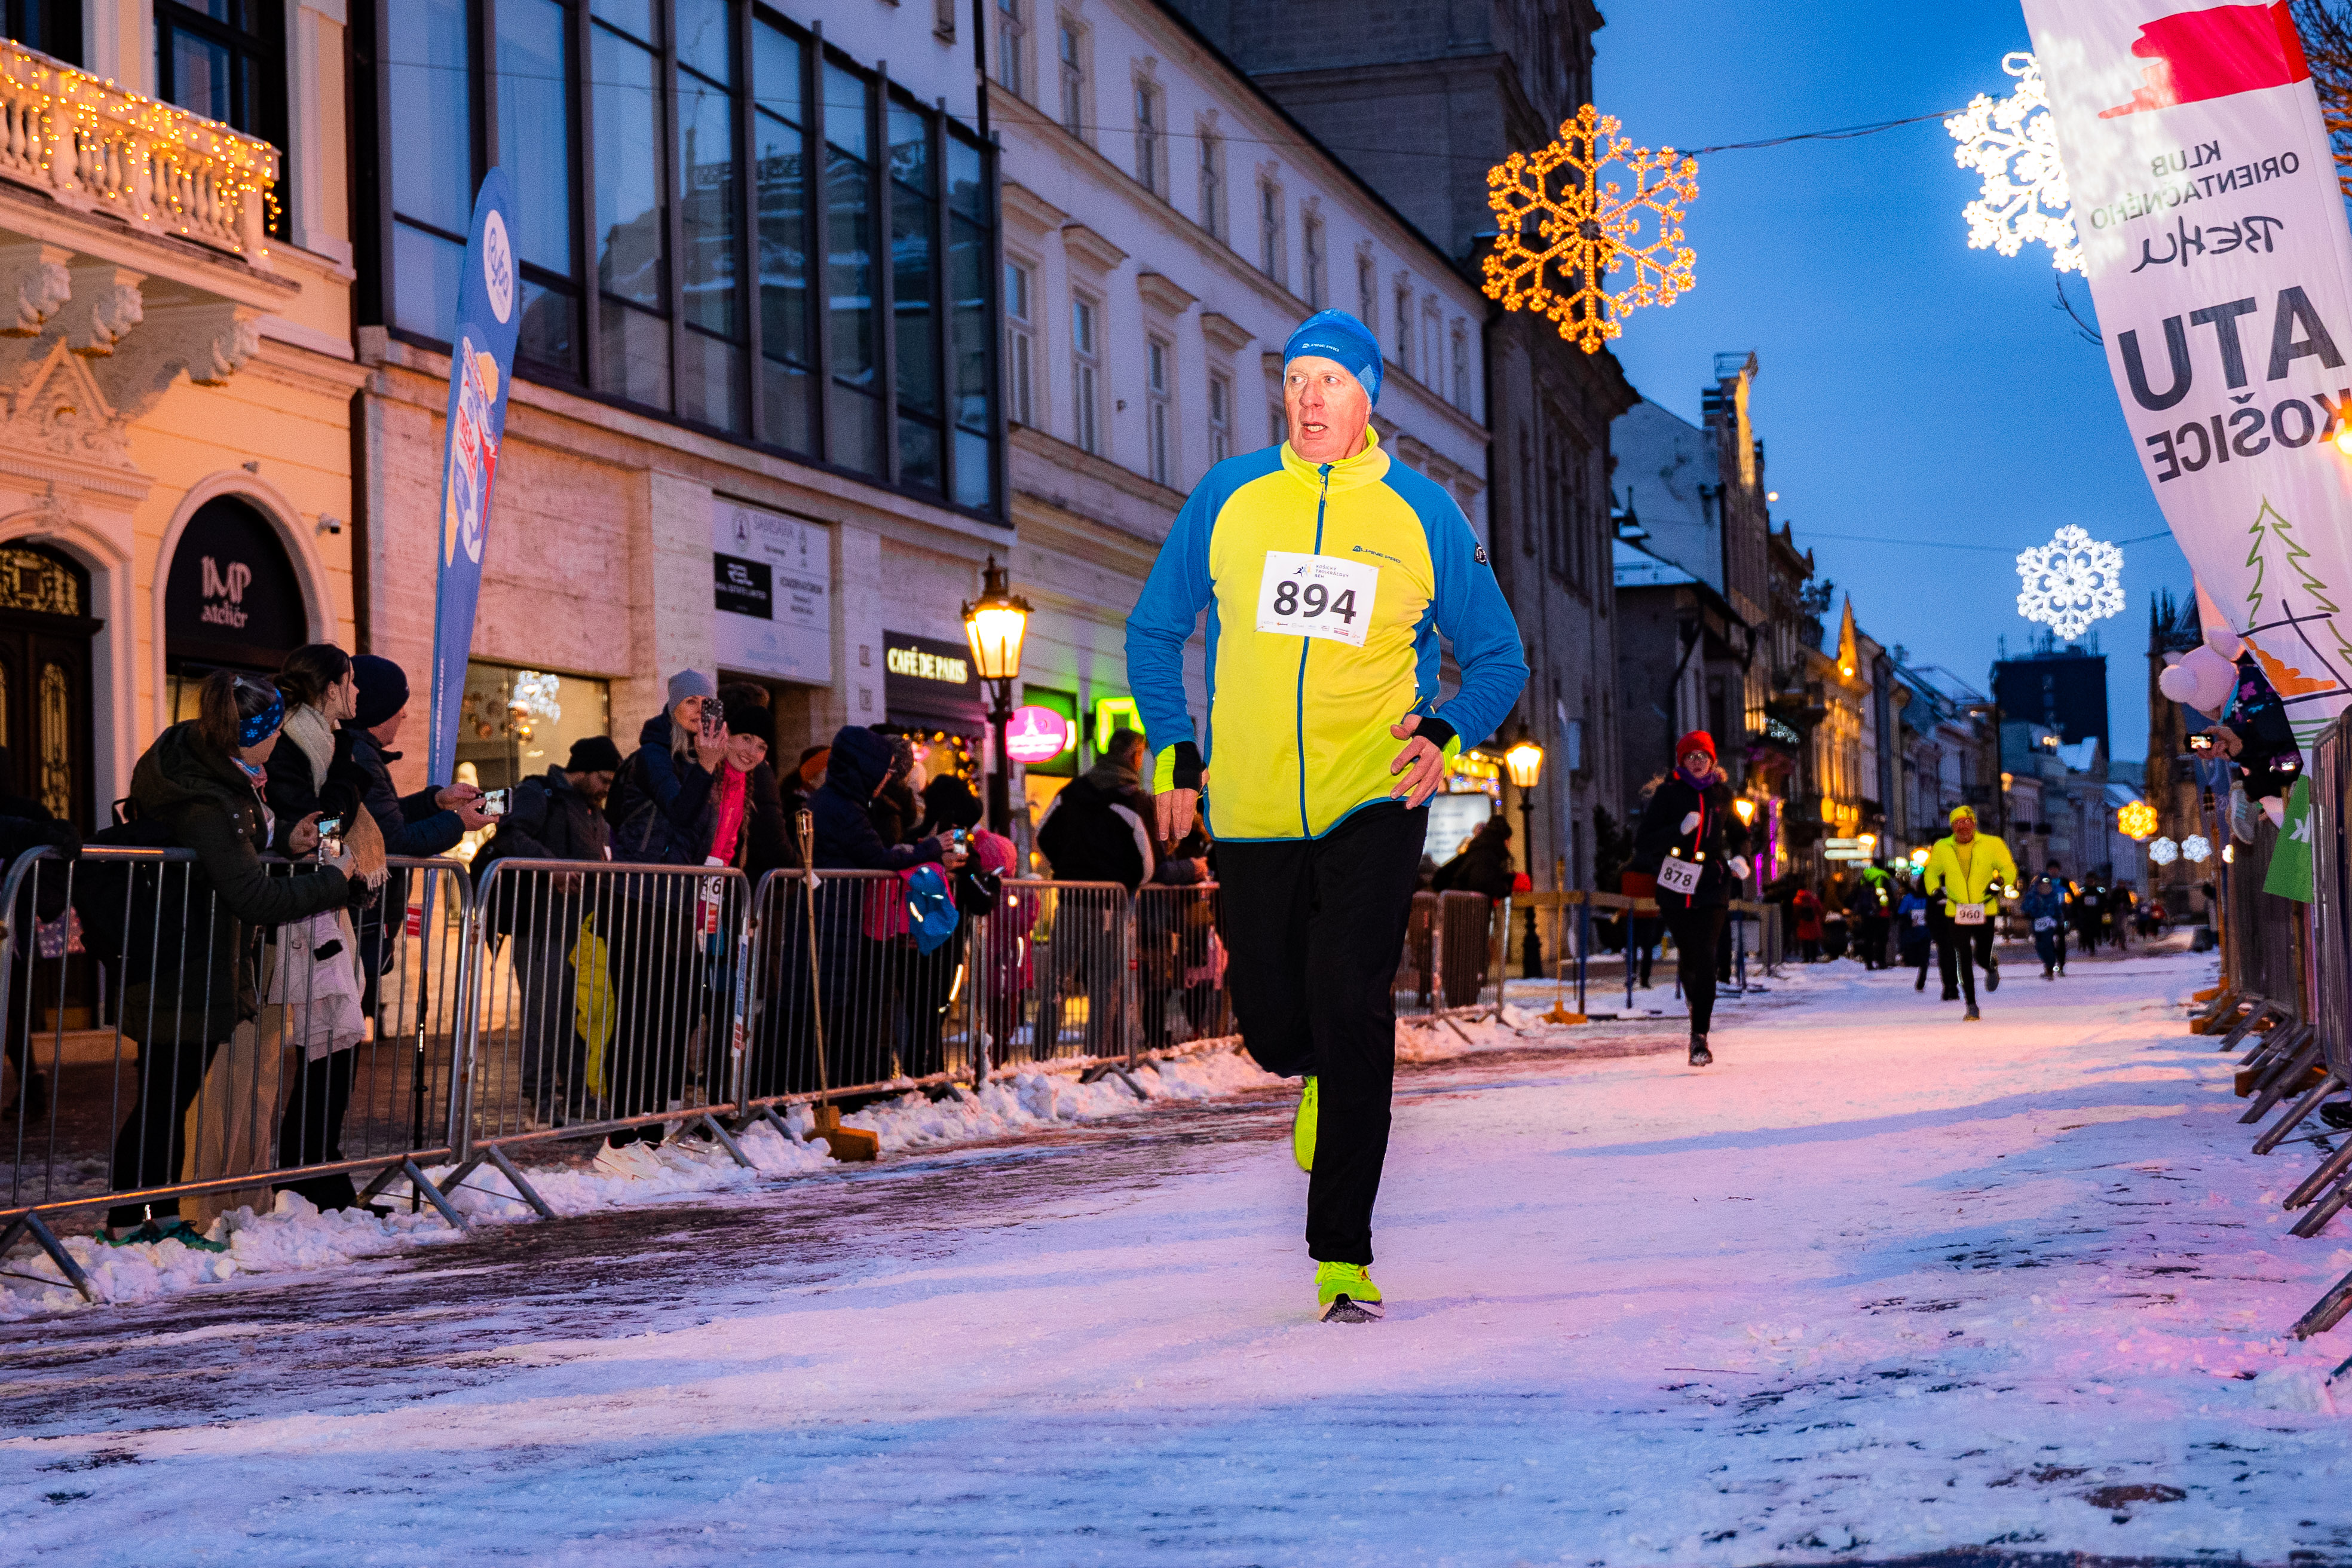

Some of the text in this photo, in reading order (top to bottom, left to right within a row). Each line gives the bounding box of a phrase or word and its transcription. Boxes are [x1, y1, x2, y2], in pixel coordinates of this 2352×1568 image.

[1385, 555, 1401, 564] PRO
[1273, 580, 1357, 624] 894
[887, 645, 968, 684] CAFÉ DE PARIS
[1664, 866, 1693, 887] 878
[1959, 909, 1980, 919] 960
